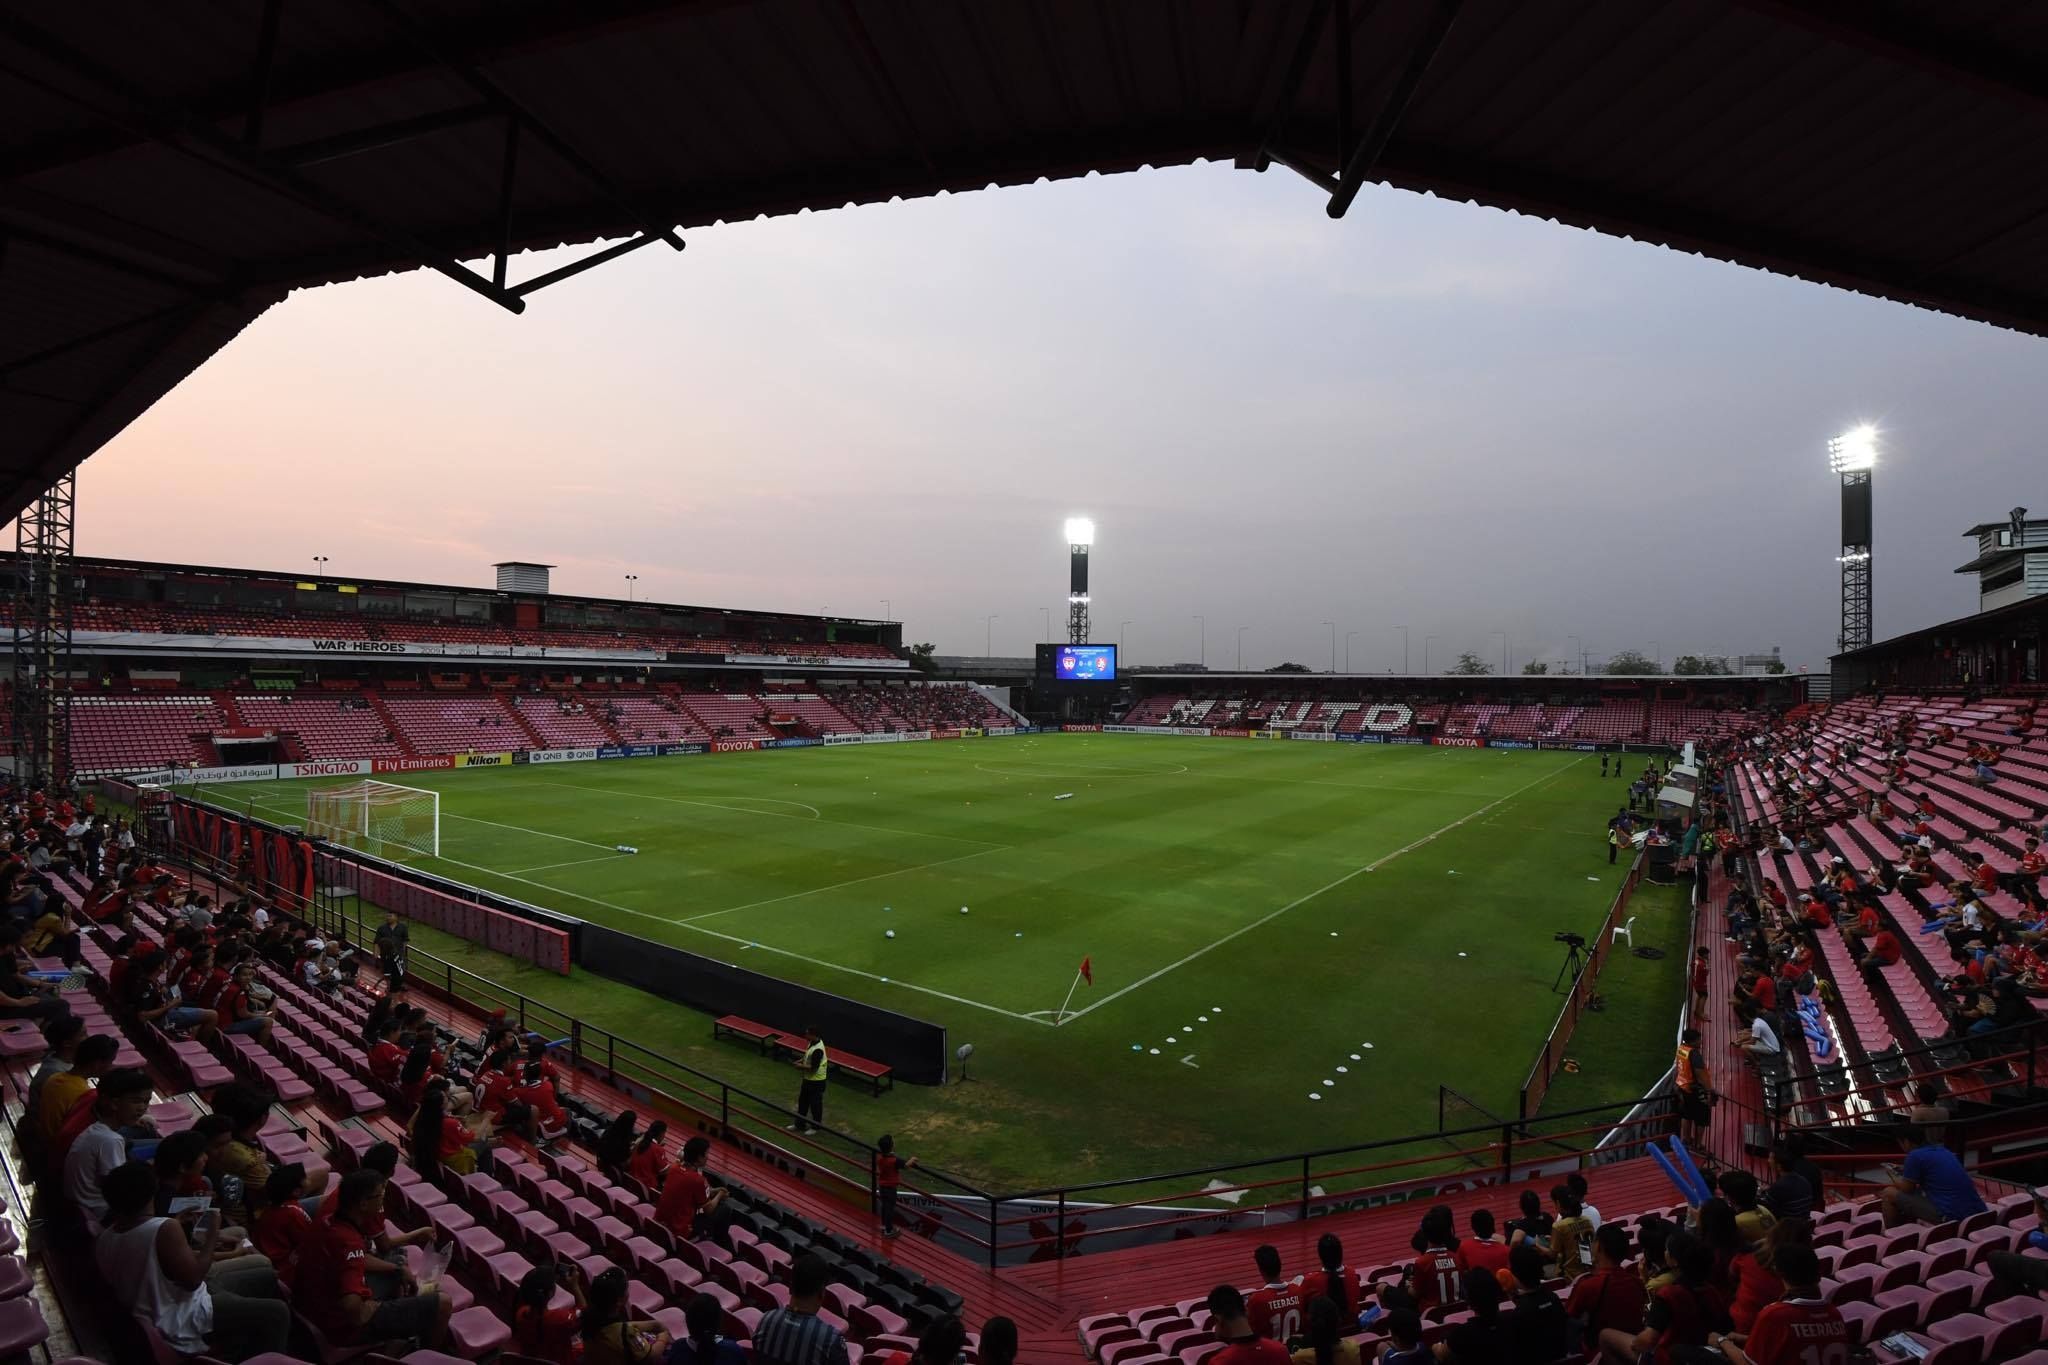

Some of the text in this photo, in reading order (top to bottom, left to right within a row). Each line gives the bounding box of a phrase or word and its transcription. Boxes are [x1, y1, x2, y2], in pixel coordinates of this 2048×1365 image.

[312, 640, 346, 650] WAR
[353, 641, 406, 652] HEROES
[786, 656, 830, 665] WAR HEROES
[1066, 724, 1097, 732] TOYOTA
[1178, 728, 1205, 736] TSINGTAO
[904, 732, 926, 740] TSINGTAO
[1212, 729, 1223, 737] Fly
[716, 741, 754, 752] TOYOTA
[1437, 738, 1478, 747] TOYOTA
[1490, 740, 1533, 749] @theafchub
[1541, 742, 1595, 751] the-AFC.com
[543, 752, 562, 760] QNB
[576, 751, 594, 759] QNB
[377, 757, 450, 772] Fly Emirates
[466, 756, 501, 766] Nikon
[293, 762, 359, 776] TSINGTAO
[346, 1249, 365, 1261] AIA
[1437, 1270, 1460, 1304] 11
[1269, 1308, 1301, 1344] 10
